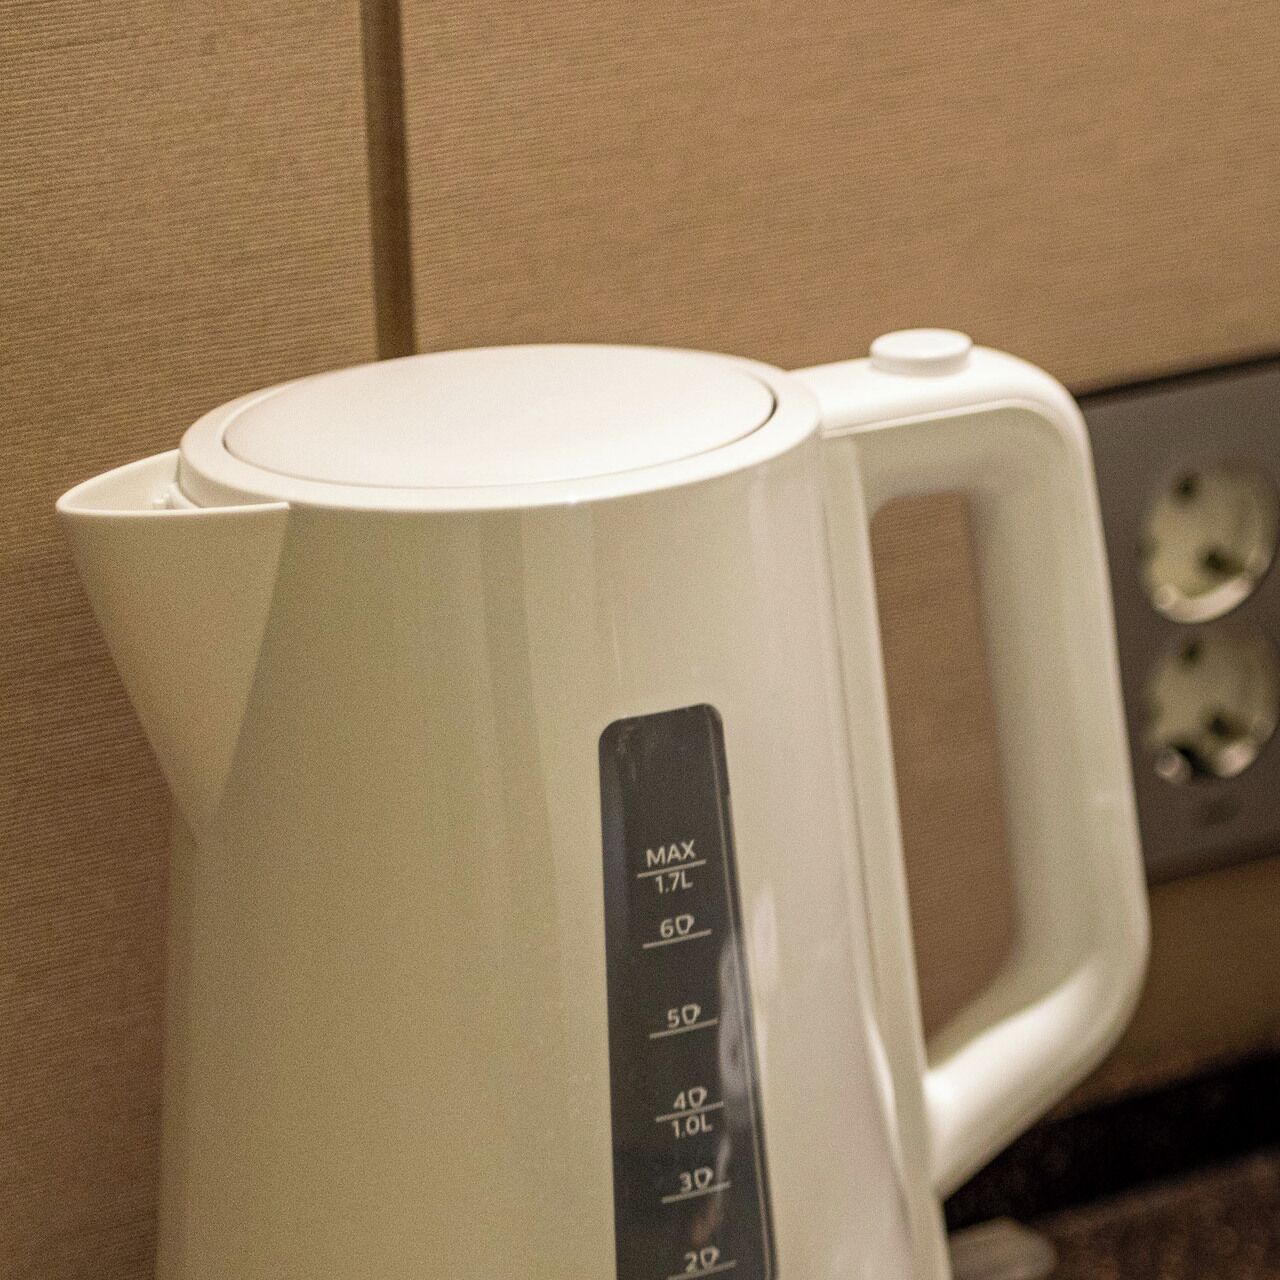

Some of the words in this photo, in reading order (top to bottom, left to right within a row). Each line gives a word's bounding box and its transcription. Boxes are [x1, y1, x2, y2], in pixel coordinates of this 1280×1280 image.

[646, 839, 696, 868] MAX
[655, 869, 694, 894] 1.7L
[672, 1113, 713, 1139] 1.0L
